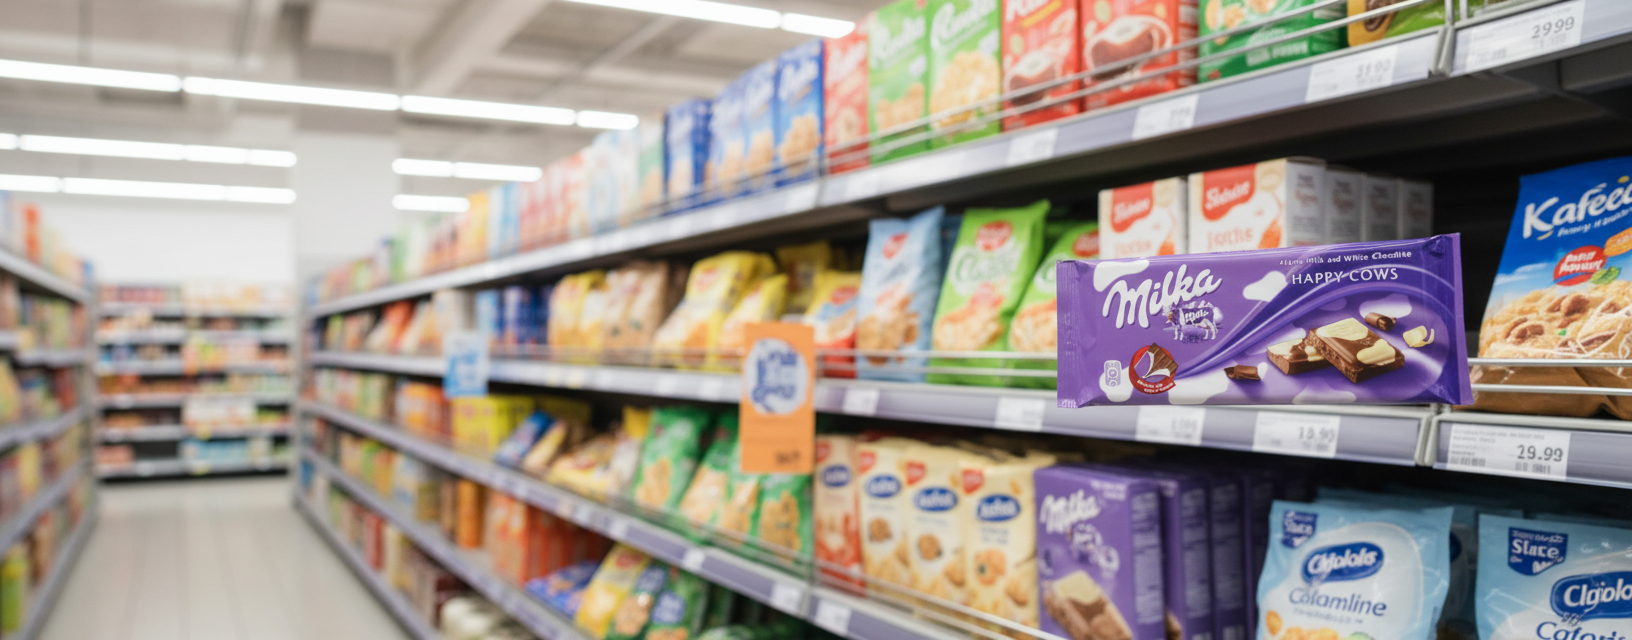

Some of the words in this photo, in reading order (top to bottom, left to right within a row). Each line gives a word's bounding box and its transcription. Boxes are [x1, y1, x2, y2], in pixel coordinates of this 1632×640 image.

[1292, 270, 1344, 284] HAPPY
[1349, 268, 1399, 282] COWS
[1102, 264, 1222, 329] Milka
